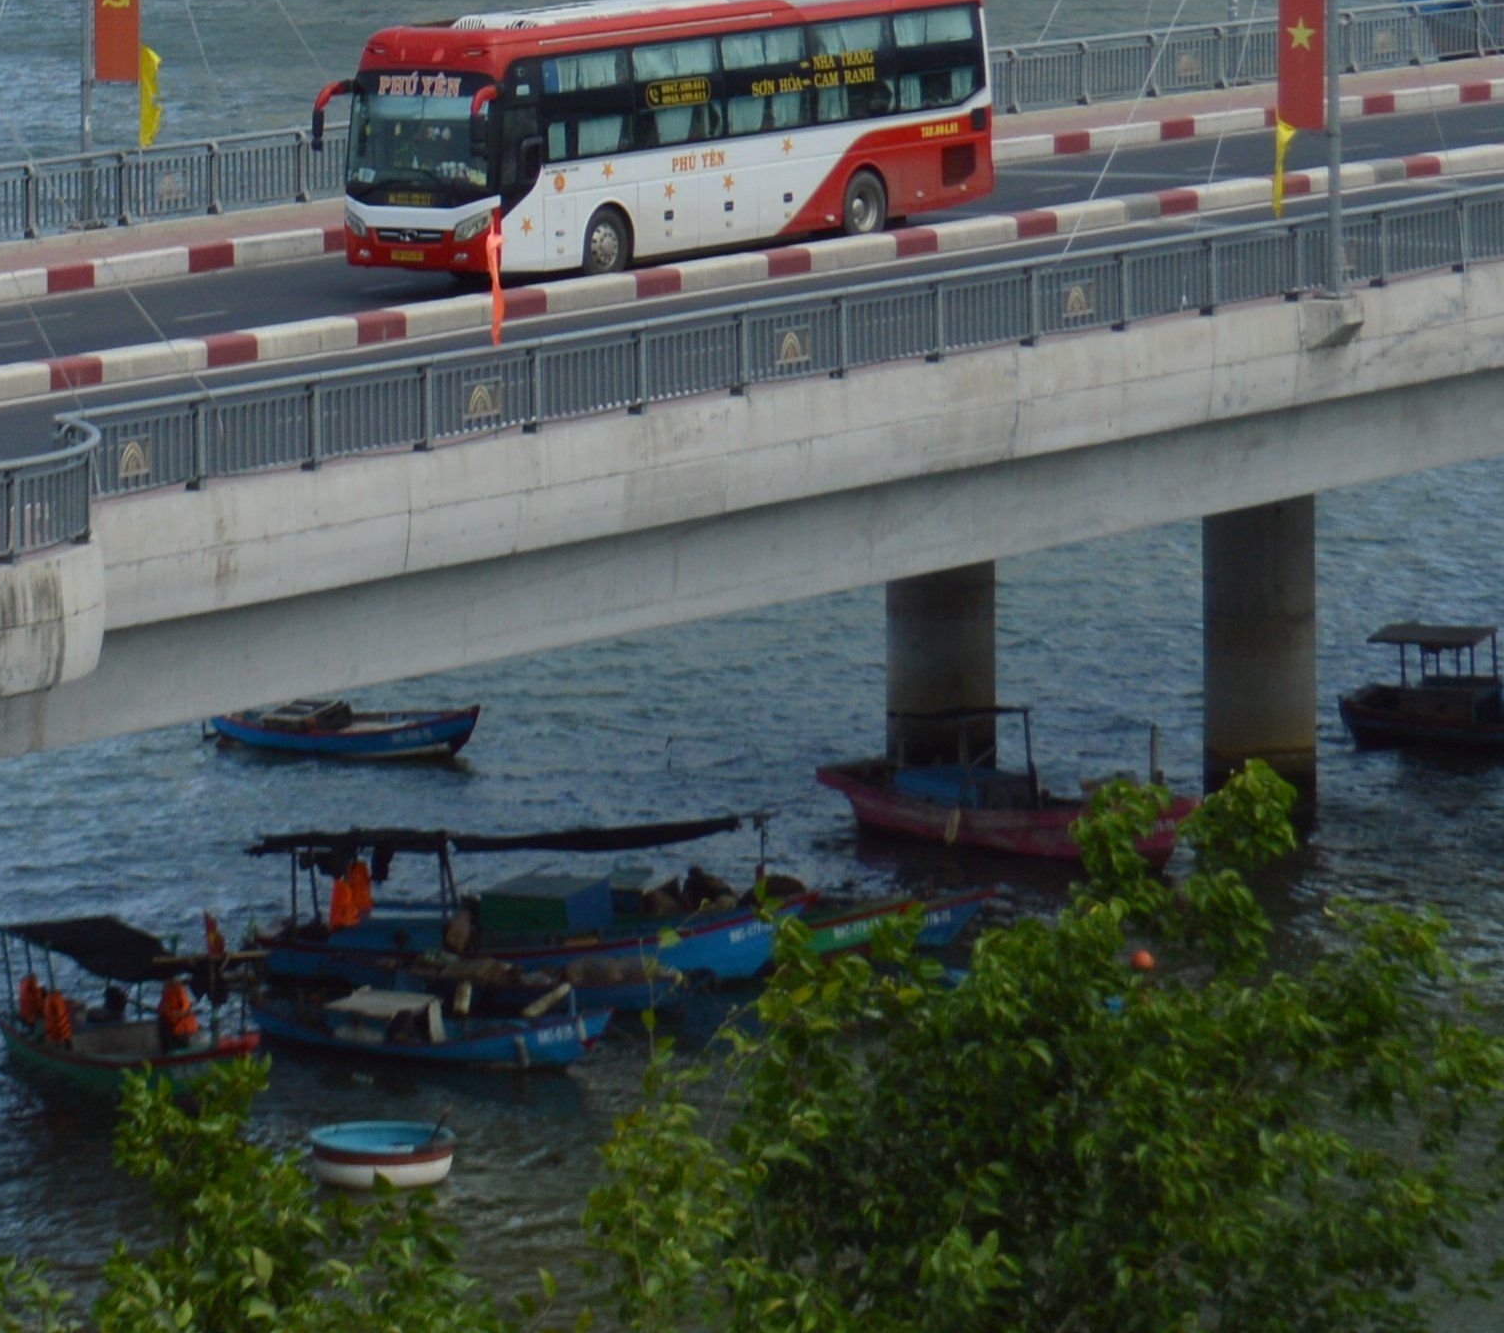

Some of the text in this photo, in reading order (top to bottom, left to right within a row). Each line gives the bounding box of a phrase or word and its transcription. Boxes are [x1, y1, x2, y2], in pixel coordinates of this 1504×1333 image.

[813, 50, 874, 70] NHA TRANG
[377, 70, 461, 98] PHÚ YÊN
[751, 79, 774, 97] SƠN
[814, 71, 839, 88] CAM
[844, 66, 875, 84] RANH
[672, 148, 725, 173] PHÚ YÊN
